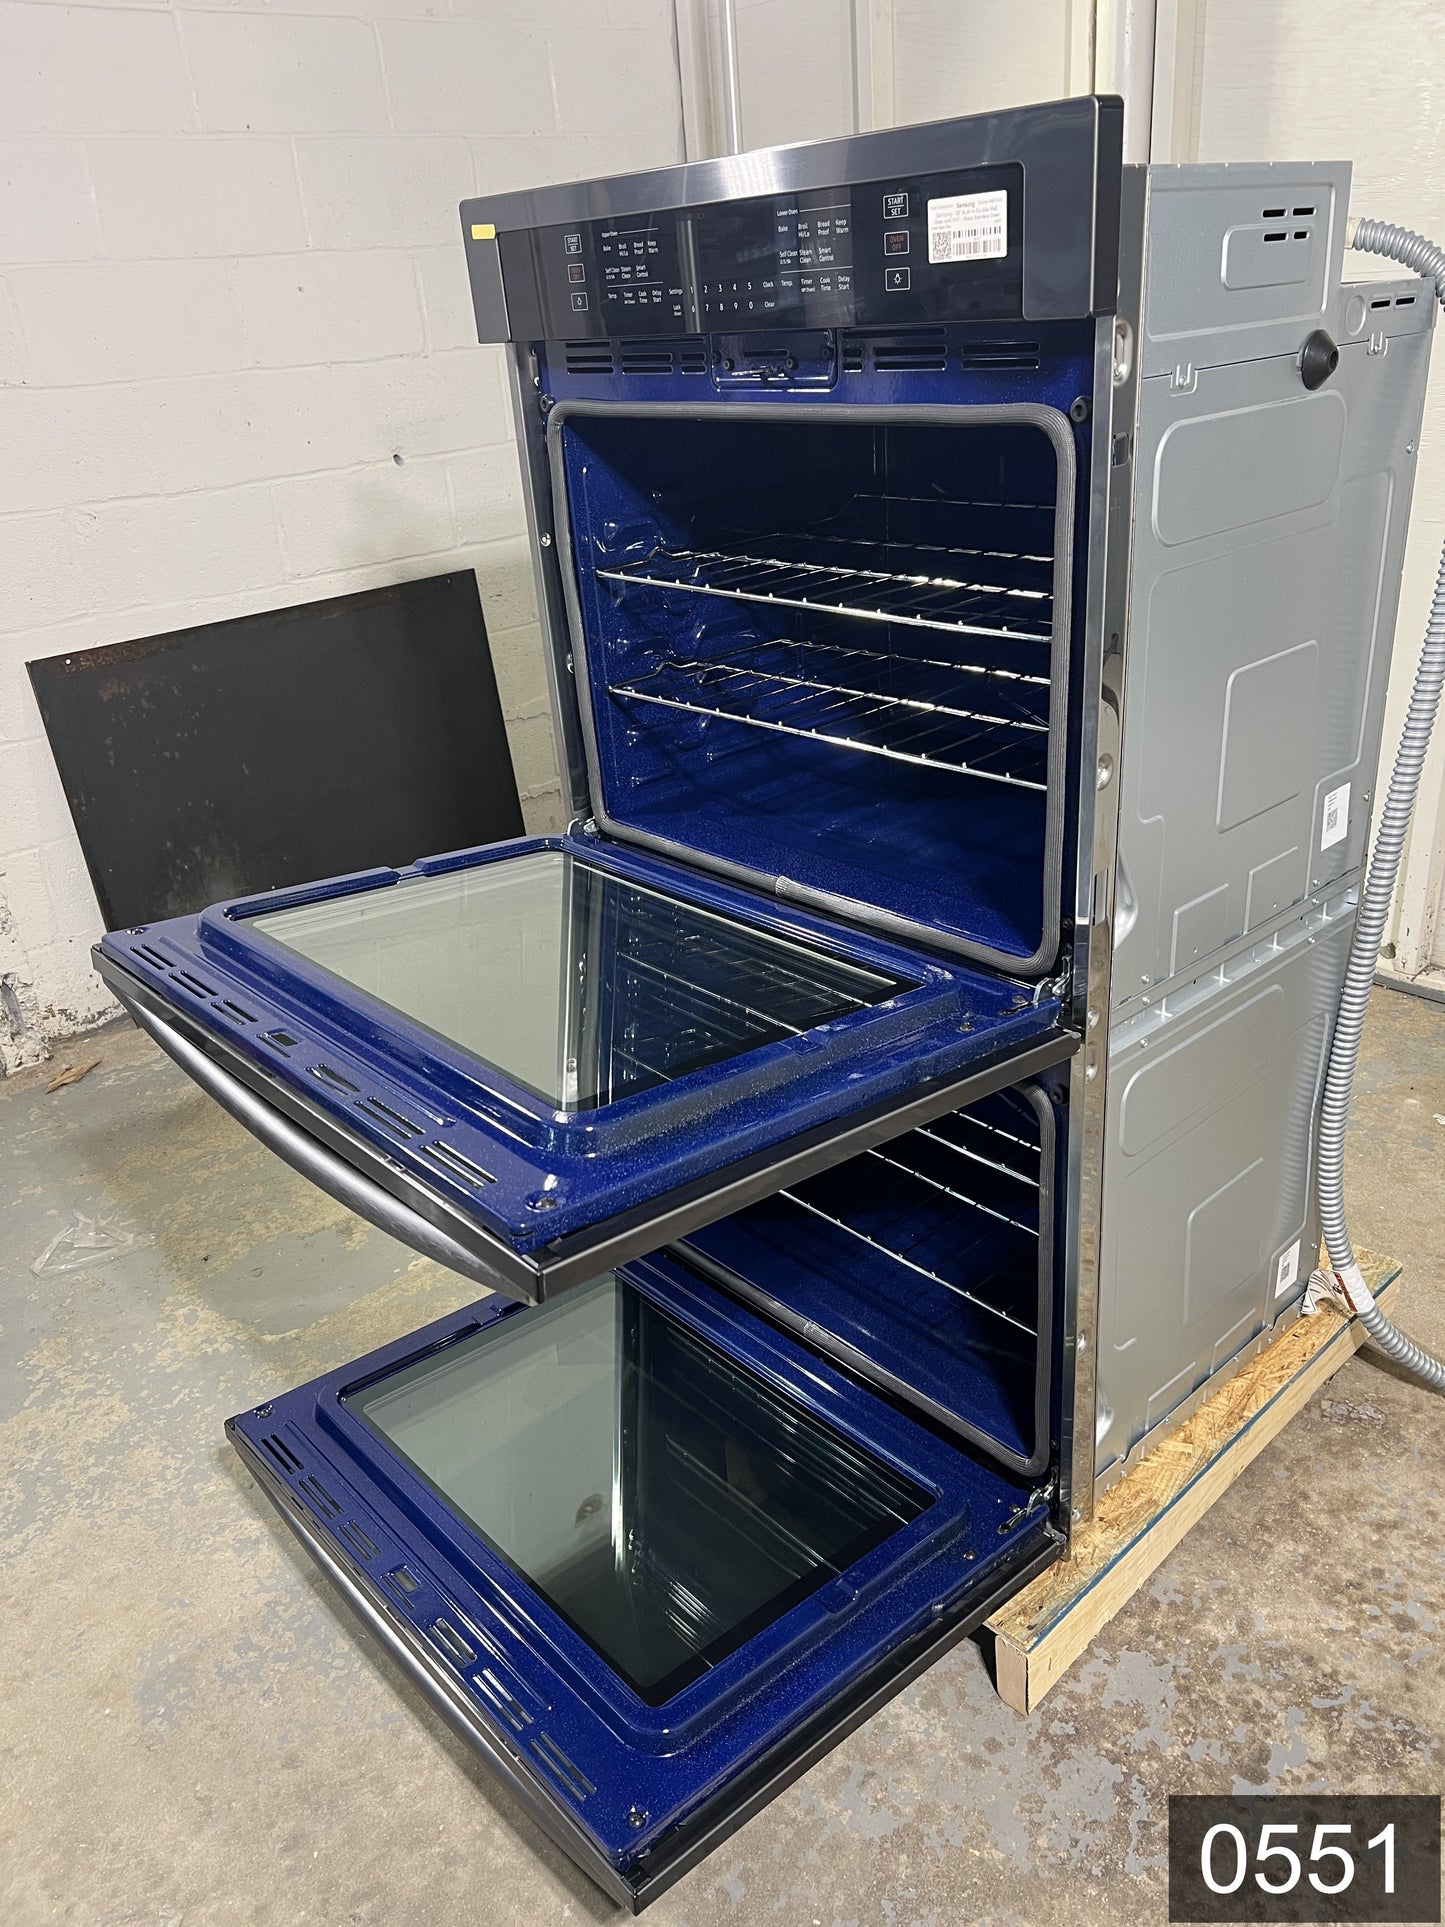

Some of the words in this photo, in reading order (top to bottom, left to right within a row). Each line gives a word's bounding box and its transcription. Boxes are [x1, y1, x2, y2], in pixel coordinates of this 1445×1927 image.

[887, 196, 904, 206] START
[891, 207, 901, 216] SET
[818, 220, 830, 228] Bread
[818, 228, 830, 236] Proof
[890, 234, 905, 243] OVEN
[892, 243, 902, 252] OFF
